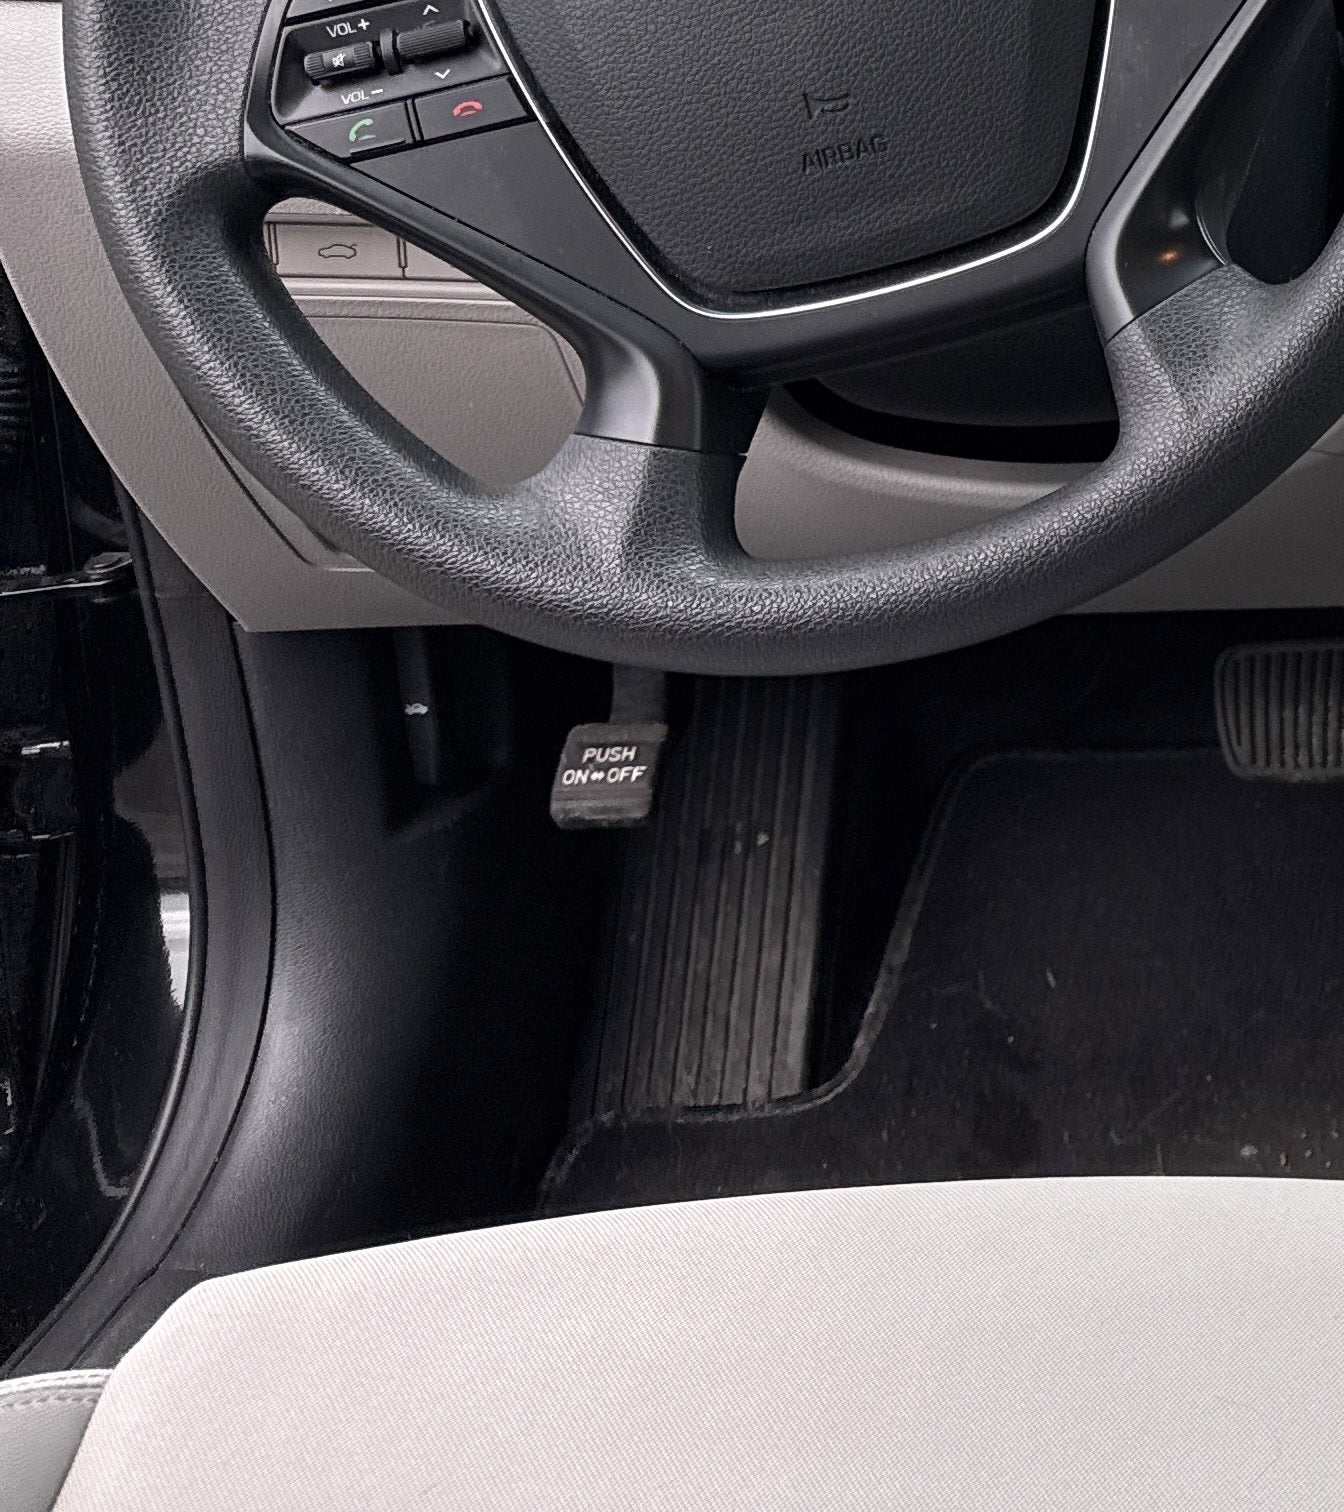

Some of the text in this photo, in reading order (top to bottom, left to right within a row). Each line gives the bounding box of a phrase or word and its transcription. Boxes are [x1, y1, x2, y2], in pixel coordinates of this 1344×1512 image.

[800, 136, 888, 174] AIRBAG
[582, 746, 637, 763] PUSH
[562, 766, 648, 786] ON OFF
